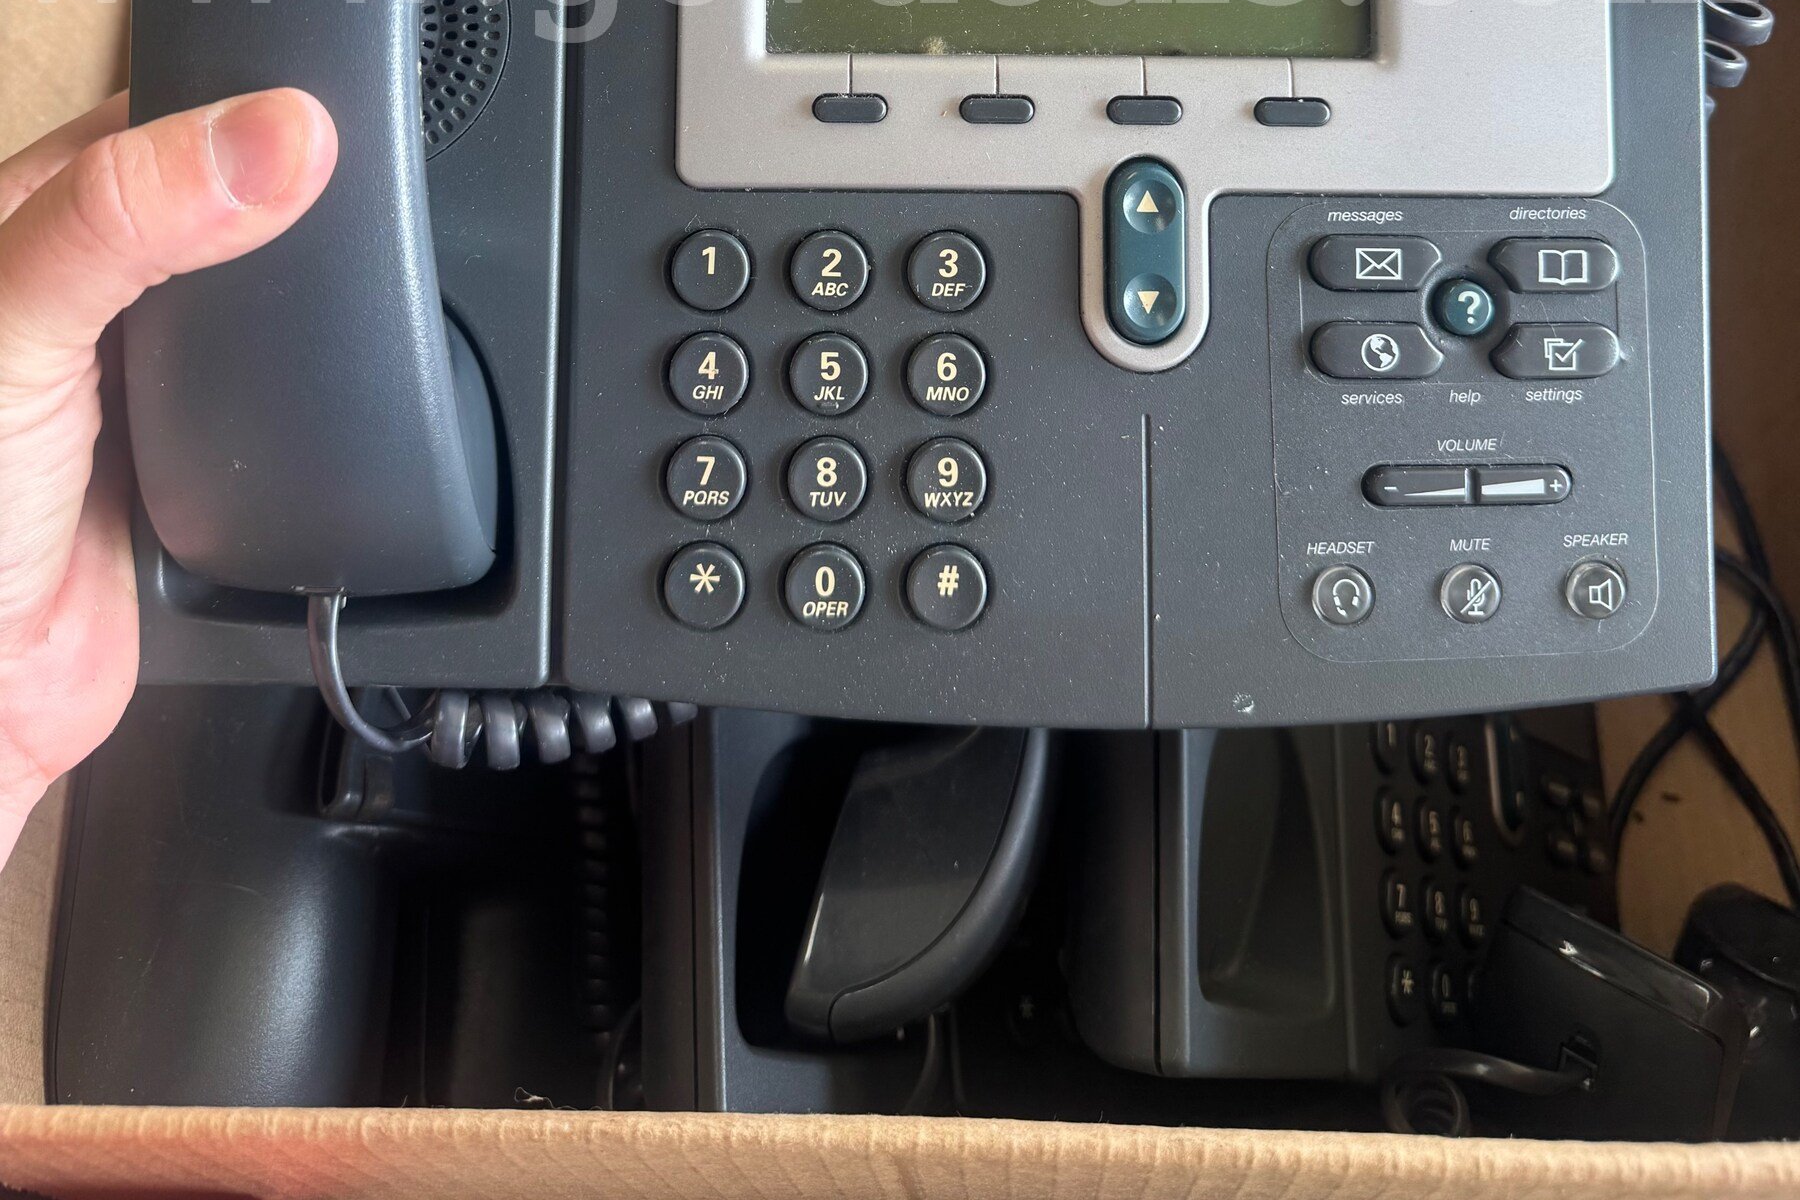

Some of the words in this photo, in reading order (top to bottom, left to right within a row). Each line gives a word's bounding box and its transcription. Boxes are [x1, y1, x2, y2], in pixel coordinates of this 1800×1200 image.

[1327, 210, 1404, 225] messages
[1509, 206, 1588, 221] directories
[701, 246, 716, 275] 1
[821, 248, 842, 278] 2
[938, 248, 959, 278] 3
[811, 281, 849, 297] ABC
[931, 282, 966, 297] DEF
[1457, 288, 1481, 325] ?
[697, 351, 720, 380] 4
[820, 351, 841, 381] 5
[936, 352, 958, 382] 6
[692, 384, 725, 400] GHI
[813, 385, 845, 401] JKL
[925, 386, 970, 402] MNO
[1340, 393, 1404, 406] services
[1448, 388, 1482, 407] help
[1525, 387, 1584, 404] settings
[1436, 438, 1498, 453] VOLUME
[696, 455, 716, 486] 7
[816, 456, 838, 488] 8
[937, 457, 959, 488] 9
[682, 490, 730, 506] PQRS
[809, 491, 847, 508] TUV
[924, 491, 974, 509] WXYZ
[1306, 540, 1376, 556] HEADSET
[1449, 537, 1492, 552] MUTE
[1562, 532, 1629, 548] SPEAKER
[814, 565, 836, 598] 0
[937, 564, 960, 597] #
[802, 601, 849, 618] OPER
[1396, 883, 1407, 909] 7
[1434, 890, 1445, 916] 8
[1469, 897, 1480, 923] 9
